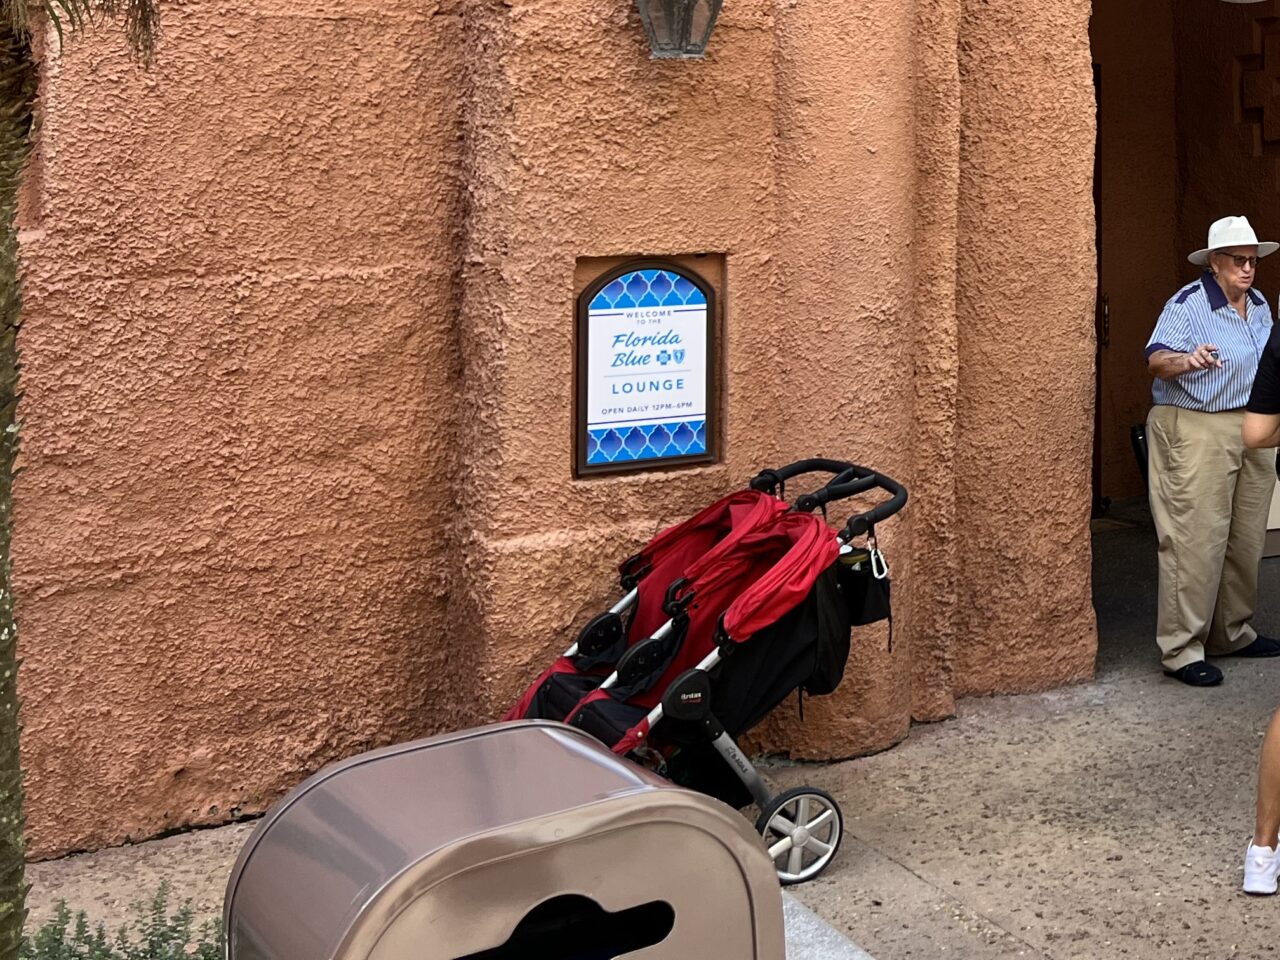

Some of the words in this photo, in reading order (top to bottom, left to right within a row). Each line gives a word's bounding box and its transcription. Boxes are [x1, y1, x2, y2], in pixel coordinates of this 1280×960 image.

[626, 310, 672, 318] WELCOME
[612, 329, 682, 348] Florida
[611, 350, 651, 367] Blue
[612, 379, 685, 394] LOUNGE
[627, 405, 649, 413] DAILY
